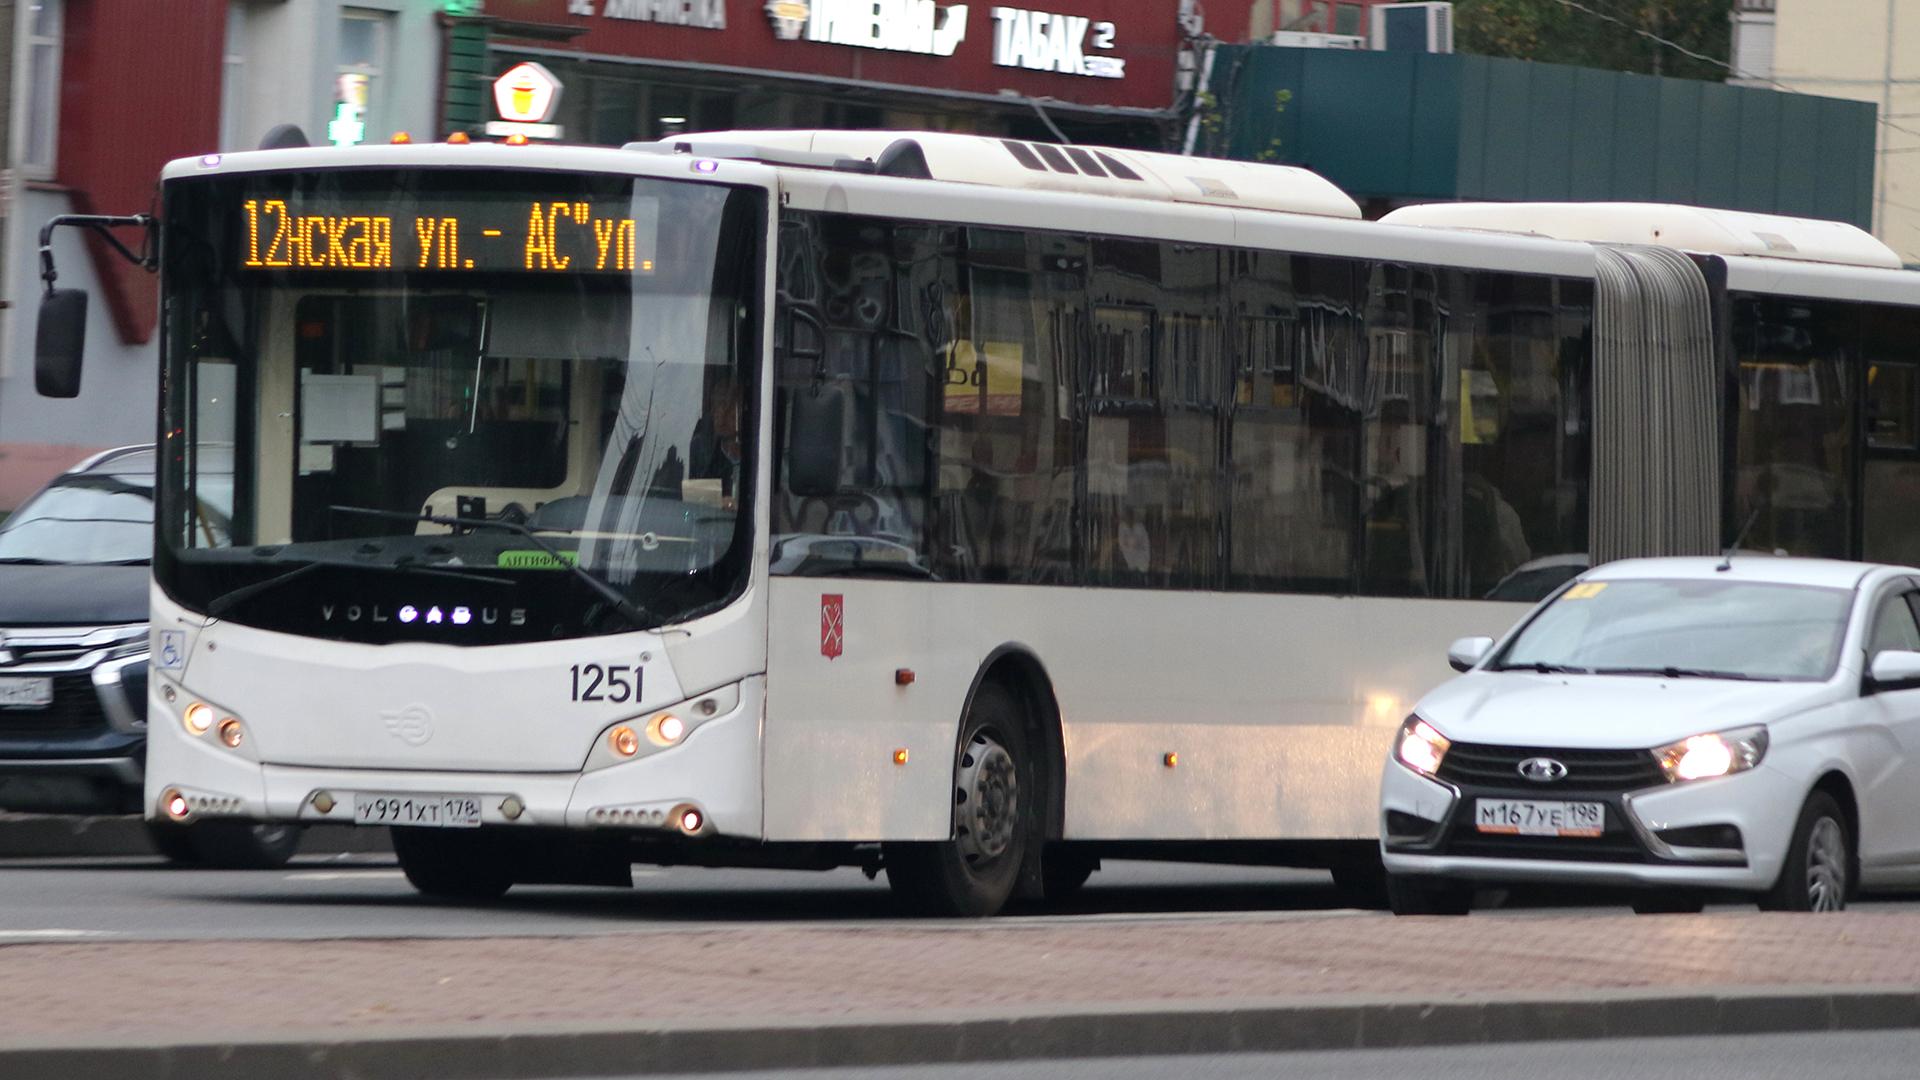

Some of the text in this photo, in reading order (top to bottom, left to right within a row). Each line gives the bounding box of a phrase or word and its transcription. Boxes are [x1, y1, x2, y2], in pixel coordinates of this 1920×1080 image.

[990, 6, 1088, 75] ТАБАК
[1092, 21, 1115, 49] 2
[415, 216, 475, 269] ул.
[321, 604, 527, 626] VOLGABUS
[569, 663, 644, 703] 1251
